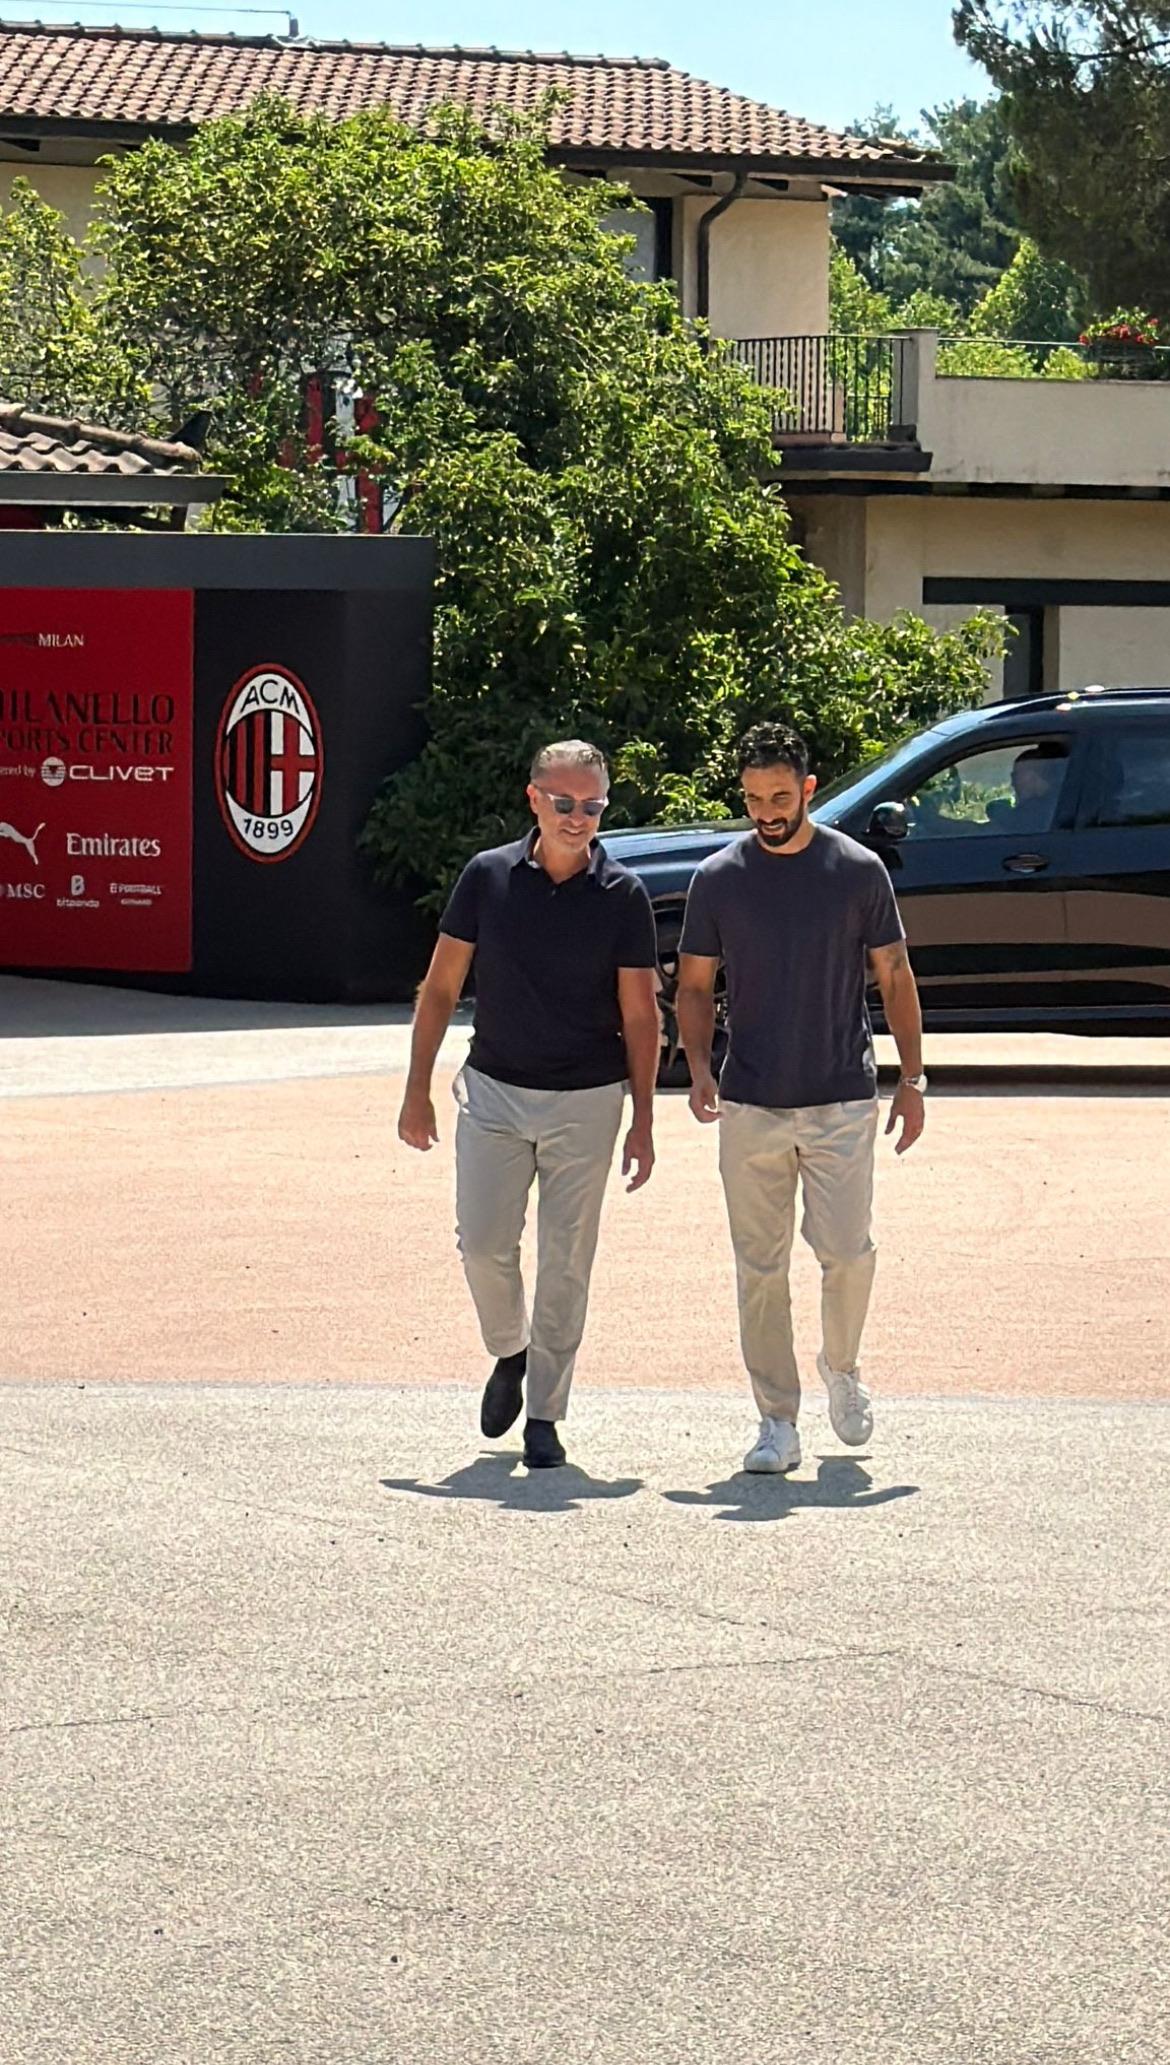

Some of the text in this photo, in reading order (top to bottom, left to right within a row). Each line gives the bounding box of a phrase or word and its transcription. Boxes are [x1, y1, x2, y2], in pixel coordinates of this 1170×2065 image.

[38, 633, 85, 648] MILAN
[240, 679, 300, 714] ACM
[78, 728, 174, 755] CENTER
[243, 818, 294, 840] 1899
[66, 832, 162, 858] Emirates
[7, 883, 46, 899] MSC
